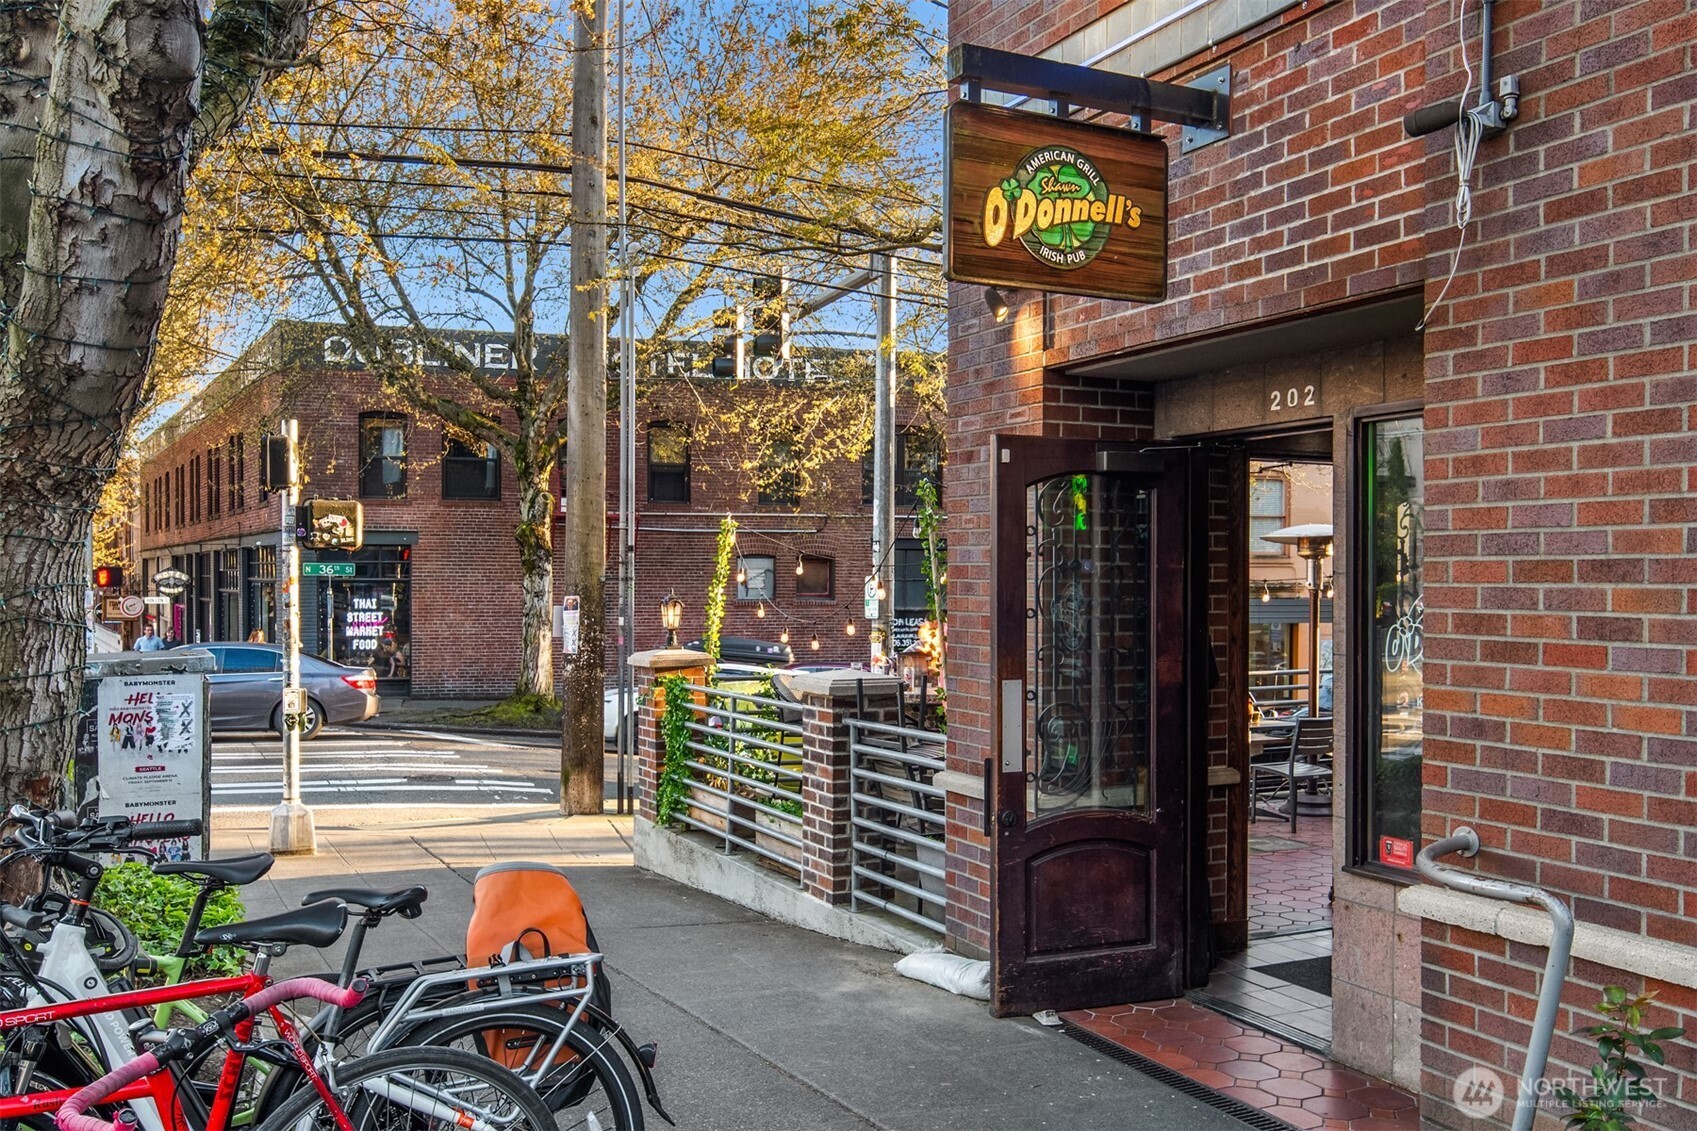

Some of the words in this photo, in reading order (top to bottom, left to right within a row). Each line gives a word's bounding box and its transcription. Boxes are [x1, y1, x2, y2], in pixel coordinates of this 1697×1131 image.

[1025, 150, 1075, 175] AMERICAN
[1076, 158, 1101, 187] GRILL
[1040, 176, 1082, 196] Shawn
[1038, 244, 1065, 264] IRISH
[1066, 249, 1086, 264] PUB
[1270, 385, 1316, 411] 202
[319, 564, 340, 574] 36th
[353, 598, 377, 610] THAI
[346, 611, 384, 623] STREET
[345, 625, 384, 637] MARKET
[352, 639, 378, 650] FOOD
[125, 800, 177, 808] BABYMONSTER
[5, 1010, 55, 1027] SPORT
[110, 1020, 135, 1057] POWER
[300, 1053, 318, 1081] SPORT
